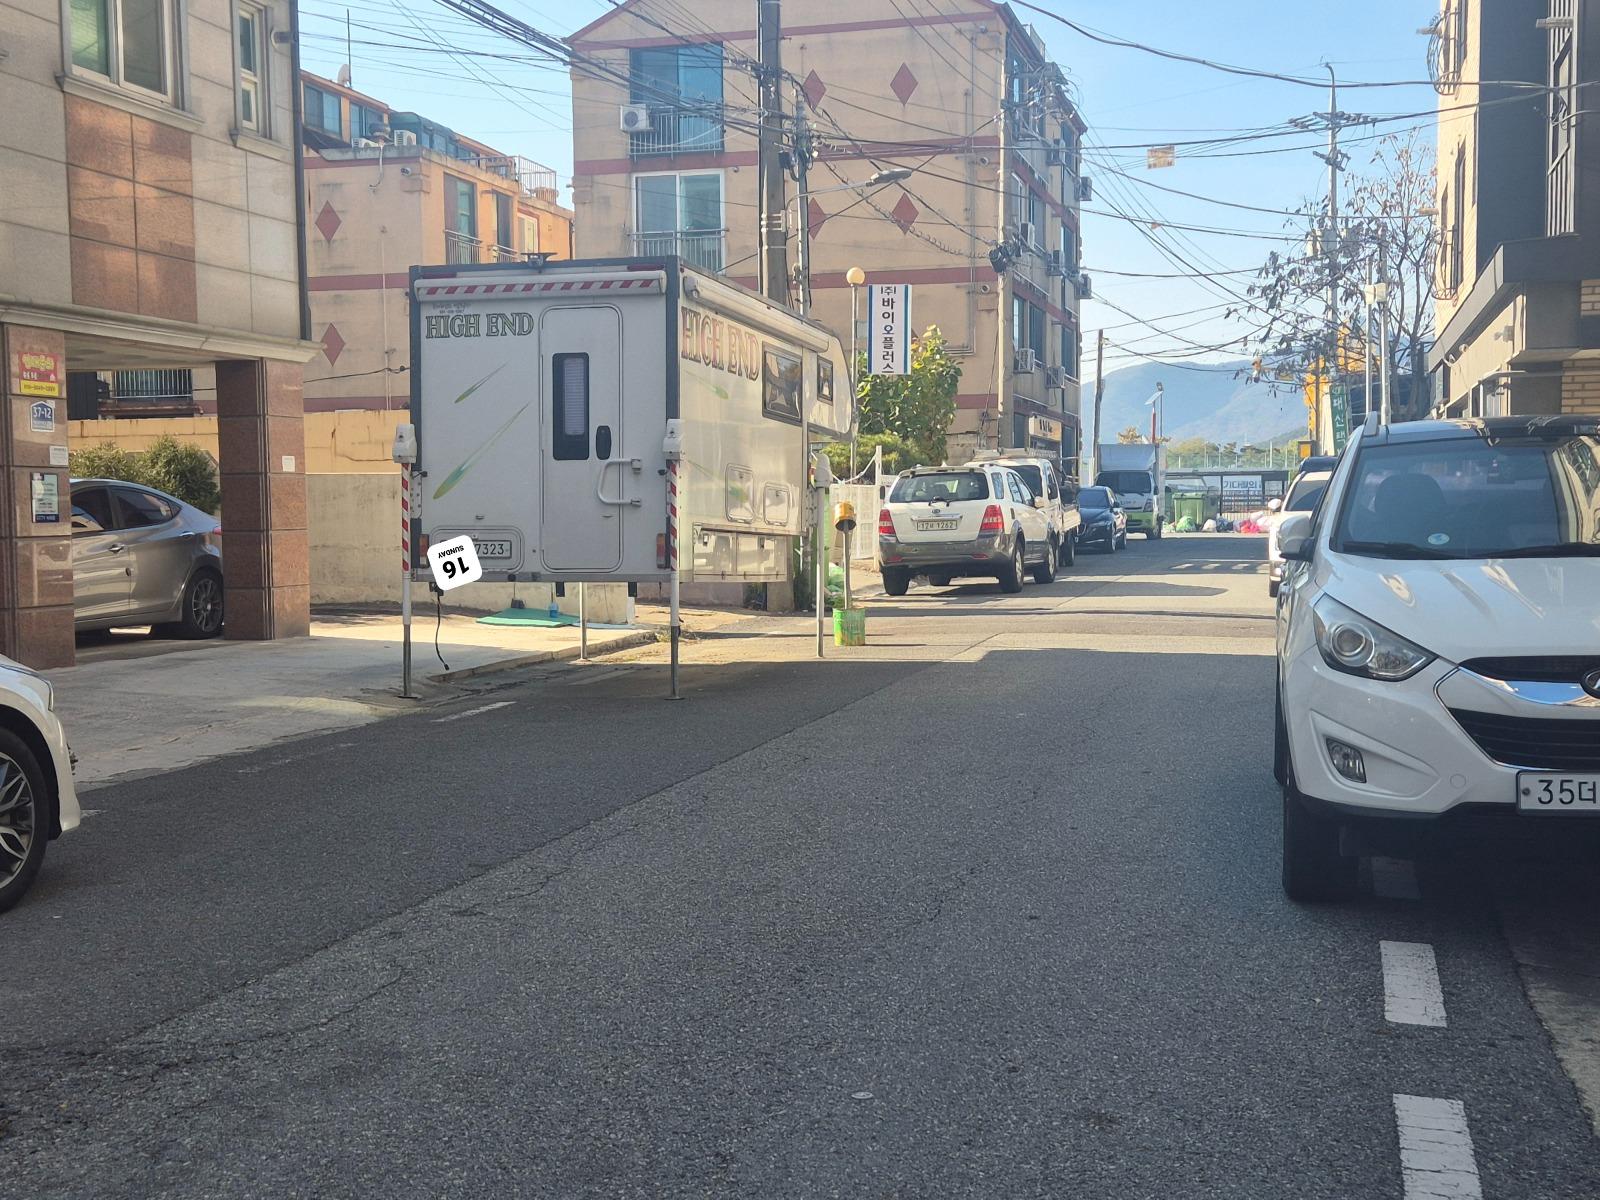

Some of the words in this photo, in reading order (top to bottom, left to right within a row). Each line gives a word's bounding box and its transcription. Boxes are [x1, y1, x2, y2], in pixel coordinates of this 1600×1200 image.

[425, 313, 481, 339] HIGH
[485, 312, 535, 337] END
[880, 285, 897, 375] (주)바이오플러스
[680, 305, 725, 371] HIGH
[727, 323, 760, 382] END
[32, 406, 52, 419] 37-12
[474, 543, 505, 555] 7323
[1537, 779, 1597, 805] 35더
